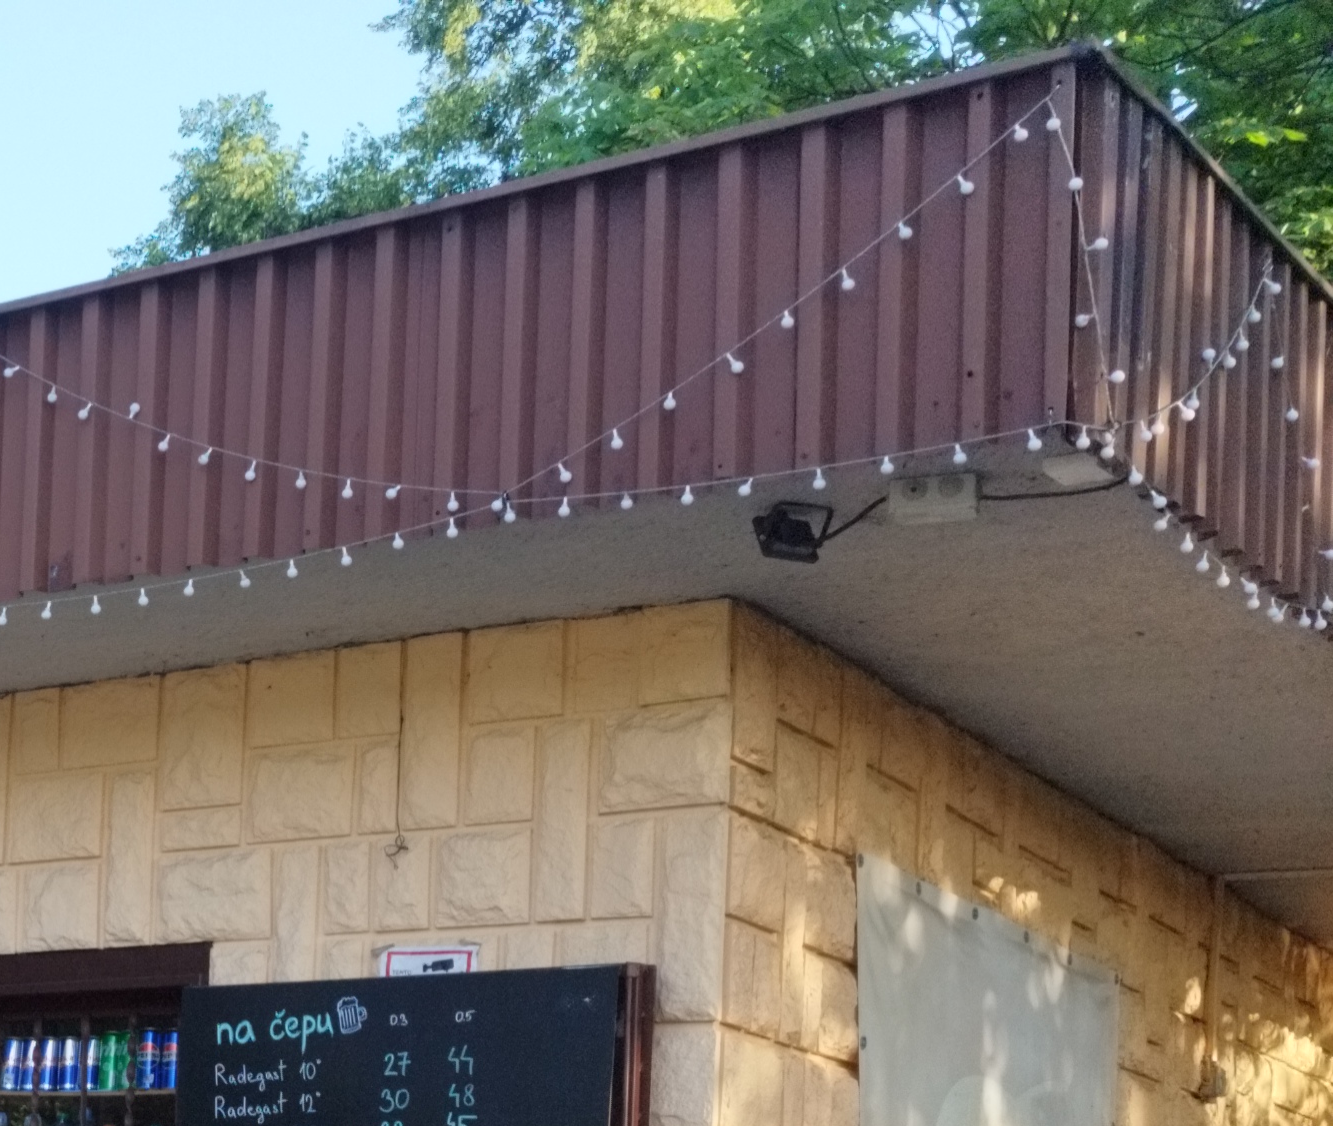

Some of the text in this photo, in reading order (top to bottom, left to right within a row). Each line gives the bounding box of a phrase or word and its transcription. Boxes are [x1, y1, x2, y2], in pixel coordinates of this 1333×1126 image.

[217, 1019, 256, 1045] na
[270, 1009, 334, 1055] čepu
[214, 1059, 287, 1092] Radegast
[384, 1051, 411, 1076] 27
[447, 1045, 474, 1075] 44
[214, 1092, 288, 1124] Radegast
[379, 1089, 410, 1113] 30
[449, 1083, 475, 1107] 48
